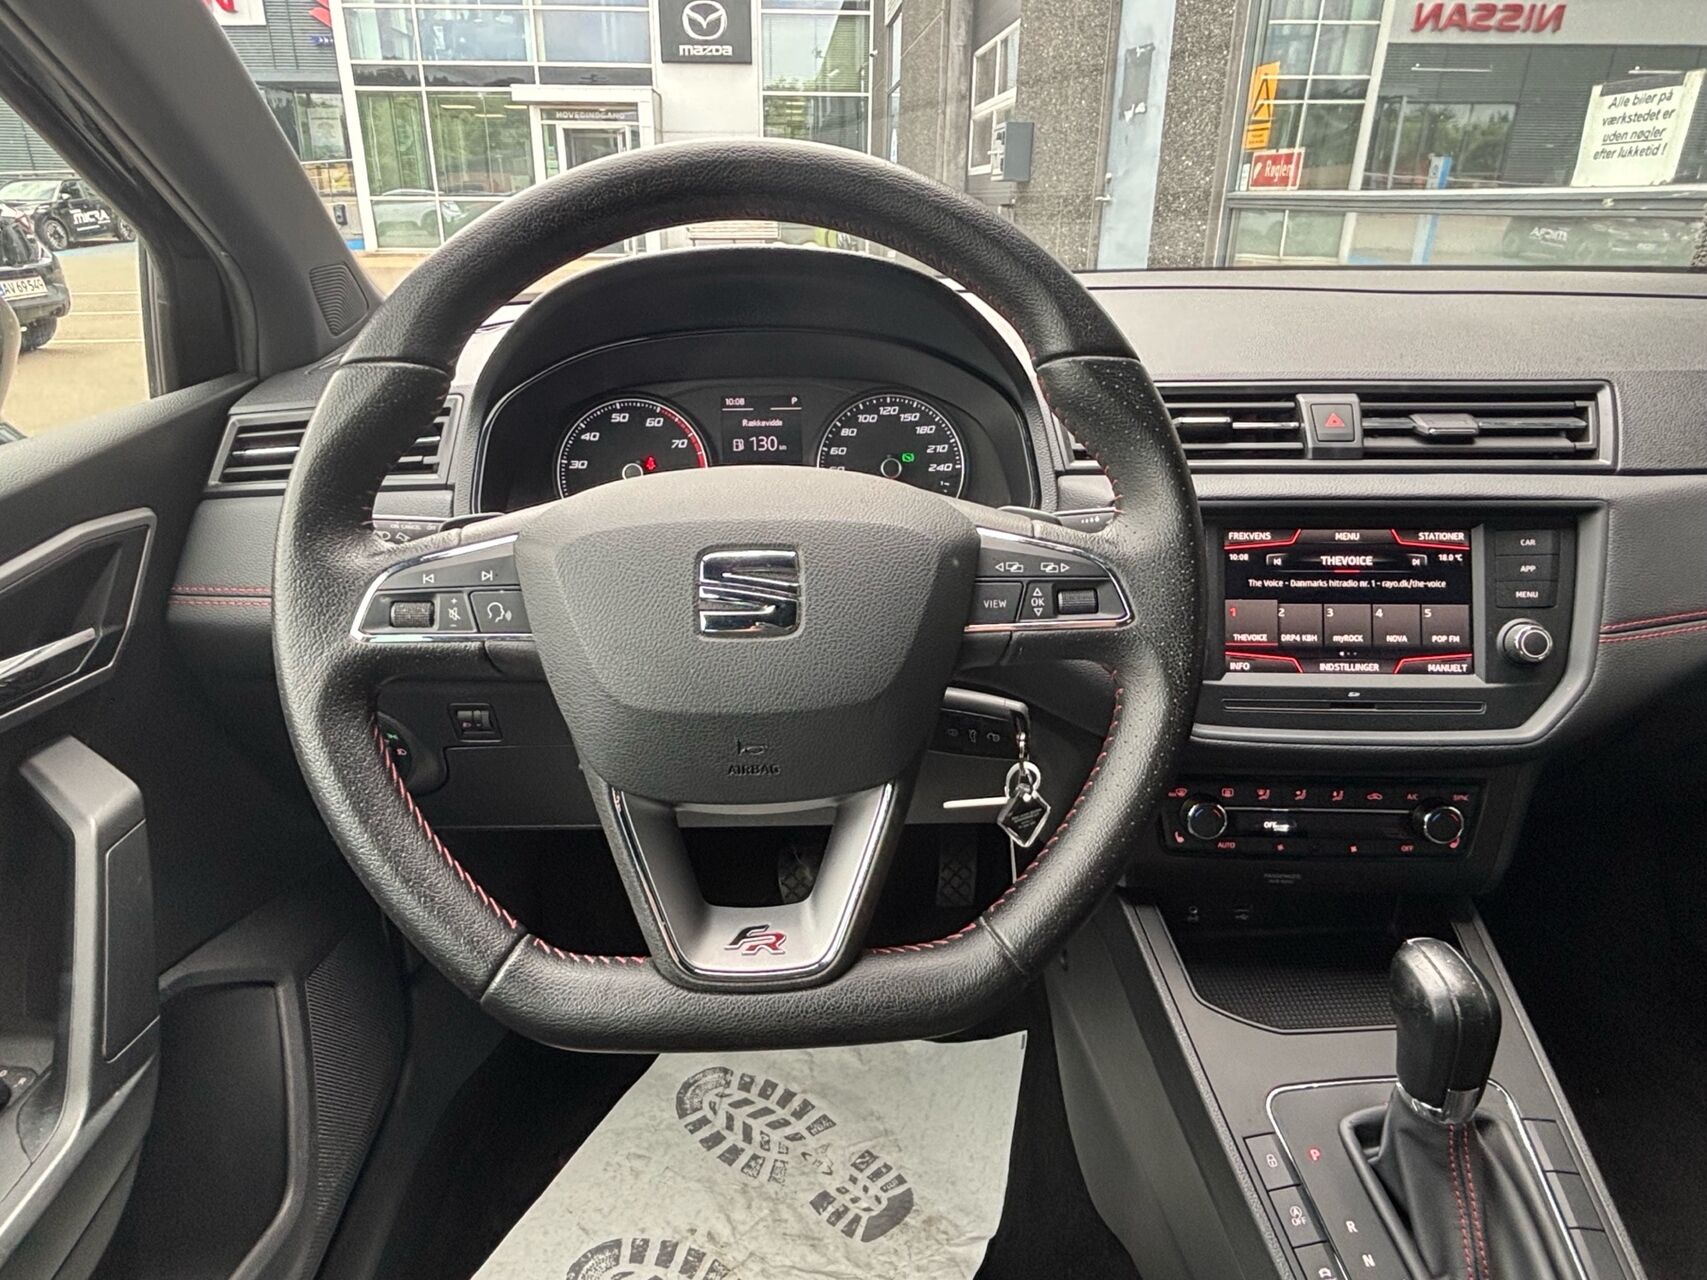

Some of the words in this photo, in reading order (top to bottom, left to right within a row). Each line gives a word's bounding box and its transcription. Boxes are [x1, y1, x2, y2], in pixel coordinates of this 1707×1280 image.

[678, 45, 733, 56] mazda
[1608, 96, 1630, 109] Alle
[1632, 93, 1658, 106] biler
[1657, 88, 1674, 105] på
[1602, 108, 1661, 126] værkstedet
[1662, 109, 1676, 119] er
[1602, 130, 1628, 142] uden
[1630, 126, 1667, 140] nøgler
[1593, 147, 1617, 160] efter
[1617, 143, 1660, 158] lukketid
[879, 406, 899, 415] 120
[611, 413, 629, 422] 50
[645, 417, 664, 427] 60
[858, 414, 878, 423] 100
[900, 413, 920, 422] 150
[840, 428, 857, 437] 80
[915, 425, 936, 434] 180
[581, 432, 600, 441] 40
[671, 439, 688, 448] 70
[749, 436, 778, 451] 130
[830, 447, 847, 455] 60
[926, 444, 948, 453] 210
[569, 460, 588, 469] 30
[928, 463, 952, 472] 240
[1228, 532, 1271, 540] FREKVENS
[1335, 532, 1360, 540] MENU
[1418, 532, 1464, 540] STATIONER
[1229, 553, 1249, 561] 10:08
[1320, 556, 1373, 566] THEVOICE
[1248, 579, 1262, 587] The
[1263, 579, 1284, 587] Voice
[1290, 579, 1328, 587] Danmarks
[1329, 579, 1358, 587] hitradio
[1382, 579, 1446, 588] rayo.dk/the-voice
[983, 600, 1007, 608] VIEW
[1031, 597, 1045, 606] OK
[1230, 608, 1237, 617] 1
[1278, 608, 1285, 617] 2
[1326, 608, 1334, 617] 3
[1375, 609, 1383, 618] 4
[1424, 609, 1432, 618] 5
[1233, 634, 1267, 642] THEVOICE
[1333, 634, 1363, 643] myROCK
[1386, 635, 1408, 643] NOVA
[1432, 635, 1448, 643] POP
[1449, 635, 1460, 643] FM
[1229, 662, 1250, 670] INFO
[1320, 663, 1380, 672] INDSTILLINGER
[1428, 664, 1468, 672] MANUELT
[728, 764, 780, 776] AIRBAG
[1310, 1149, 1320, 1160] P
[1346, 1220, 1358, 1233] R
[1362, 1254, 1375, 1267] N
